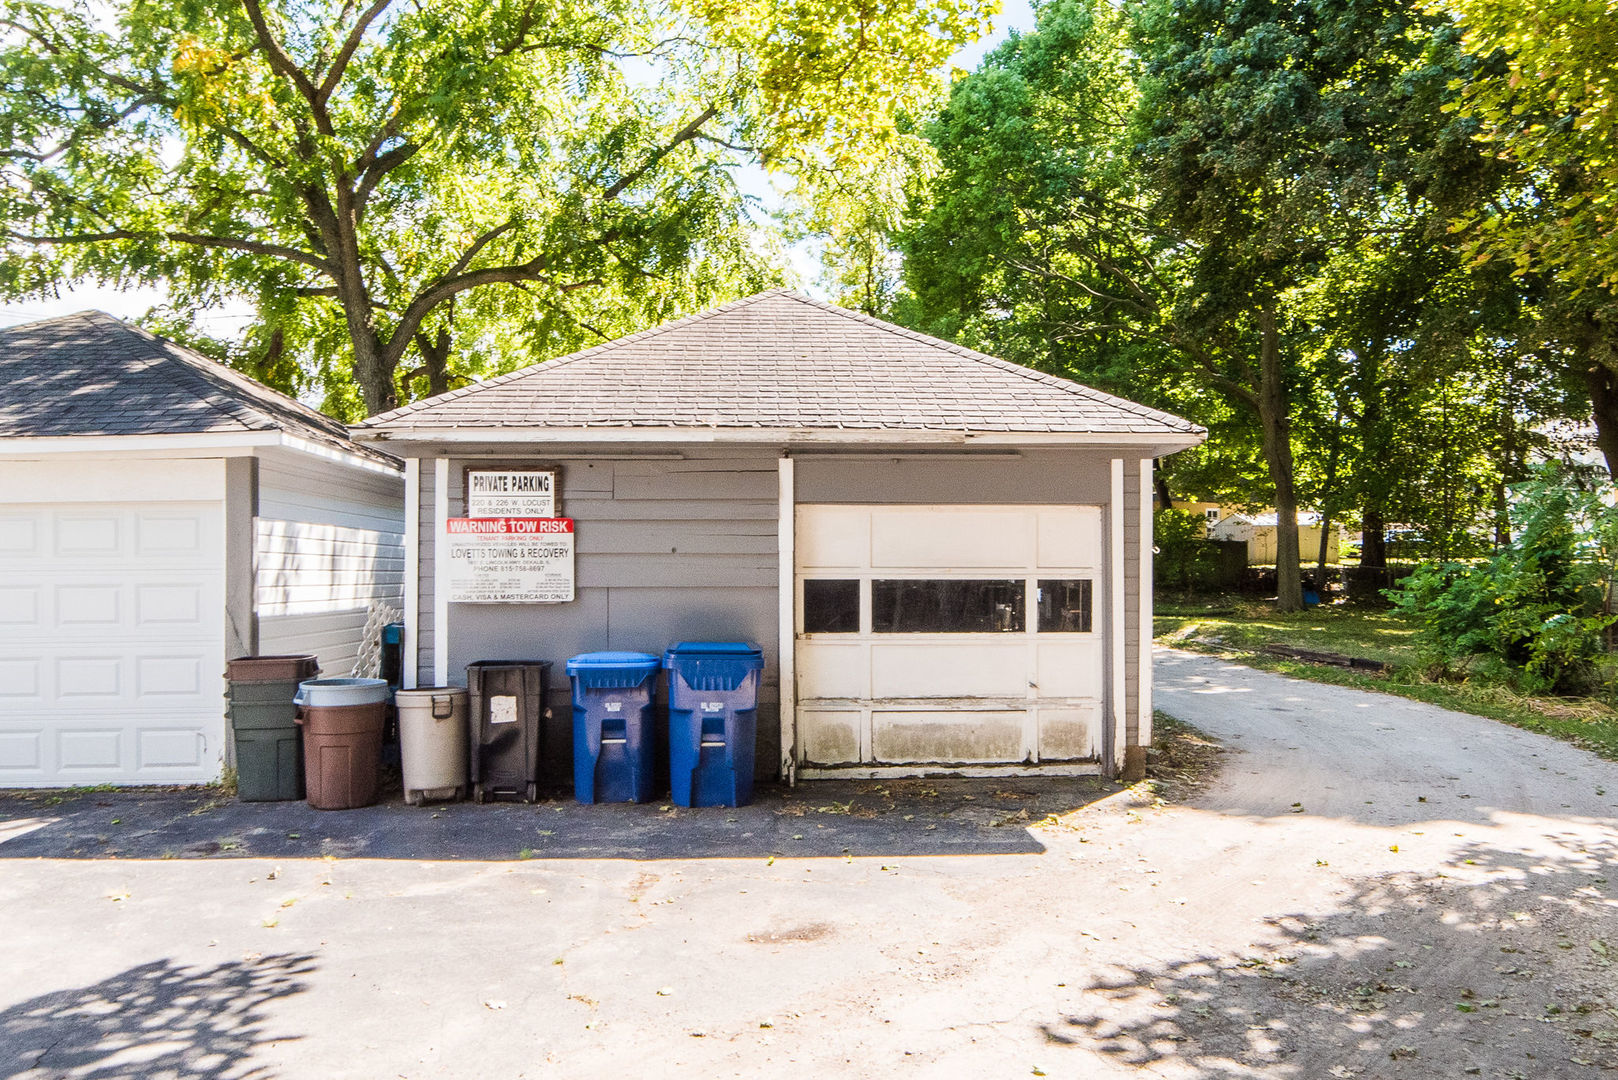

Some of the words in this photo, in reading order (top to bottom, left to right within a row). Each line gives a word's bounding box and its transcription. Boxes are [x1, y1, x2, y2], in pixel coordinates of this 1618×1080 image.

[473, 476, 508, 492] PRIVATE
[512, 476, 549, 492] PARKING
[450, 521, 506, 532] WARNING
[510, 521, 537, 532] TOW
[540, 521, 568, 532] RISK
[451, 548, 486, 559] LOVETTS
[488, 548, 518, 558] TOWING
[520, 548, 525, 558] &
[528, 548, 569, 558] RECOVERY
